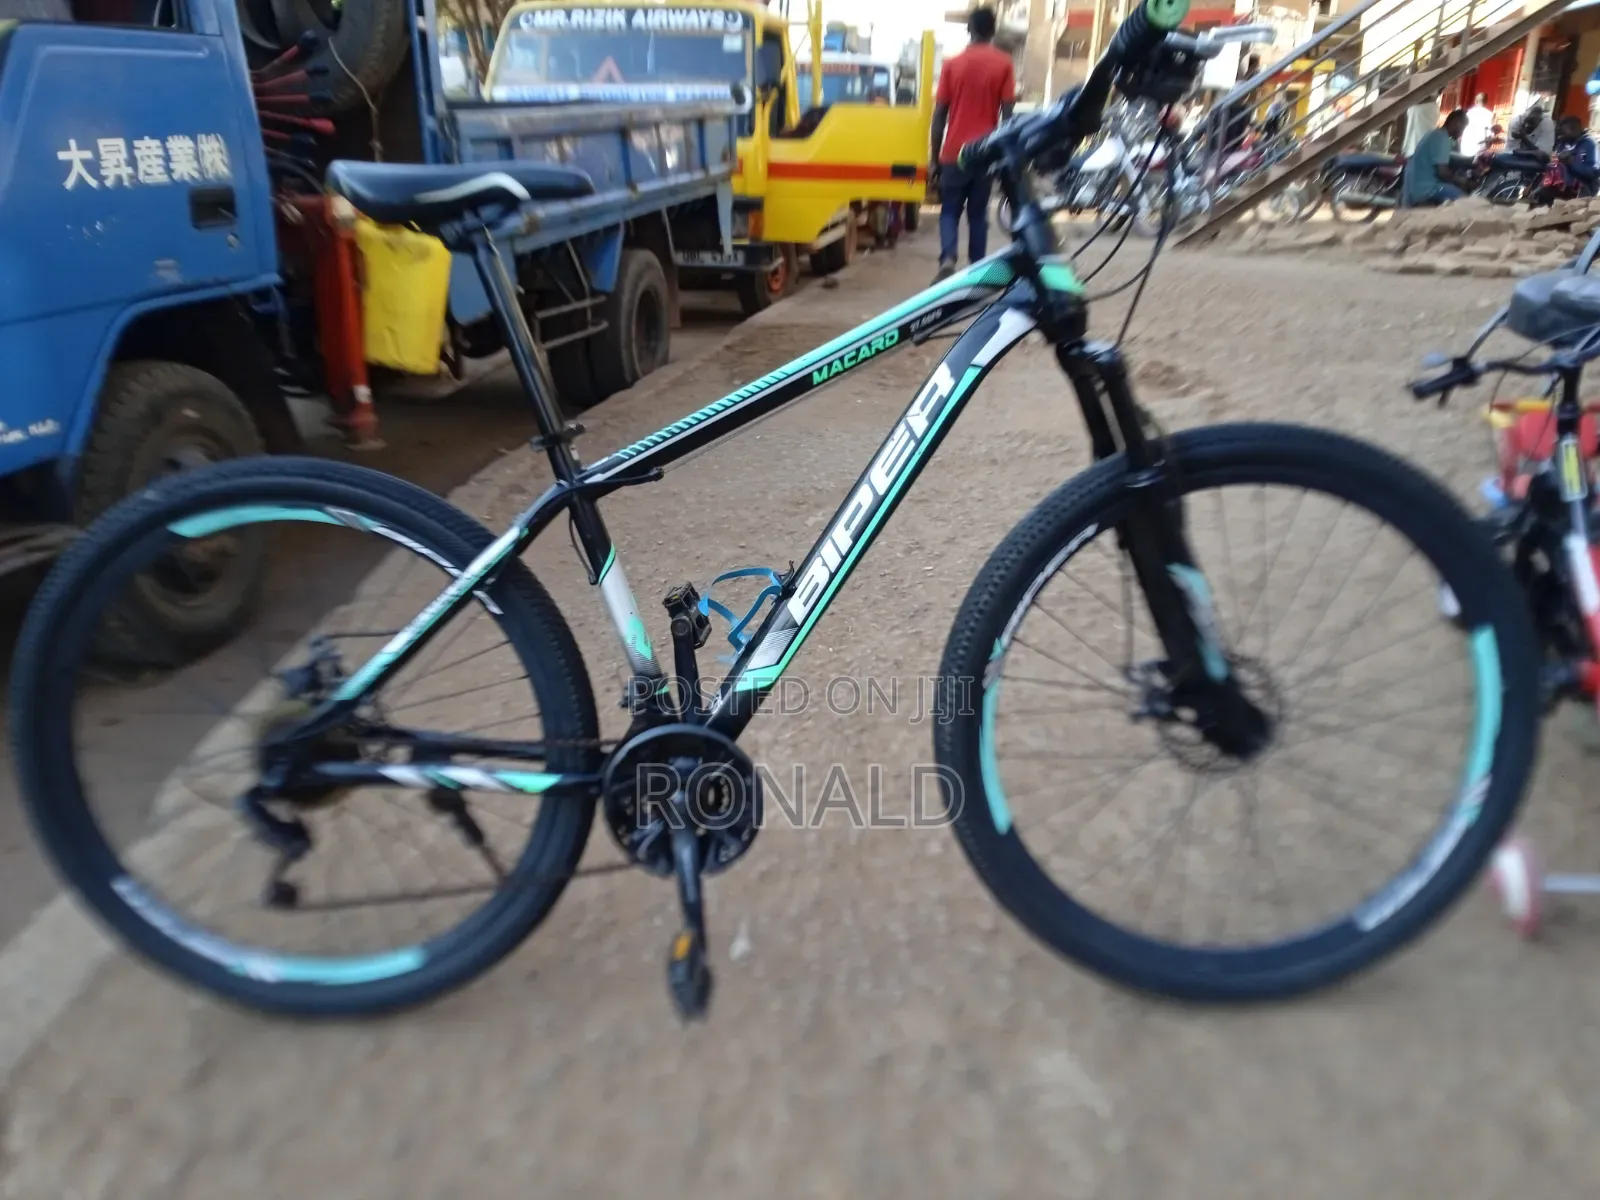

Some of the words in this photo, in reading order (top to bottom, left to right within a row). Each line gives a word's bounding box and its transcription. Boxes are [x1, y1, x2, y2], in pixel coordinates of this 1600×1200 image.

[631, 8, 725, 31] AIRWAYS
[812, 327, 899, 385] MACARD
[787, 361, 955, 626] BIPER
